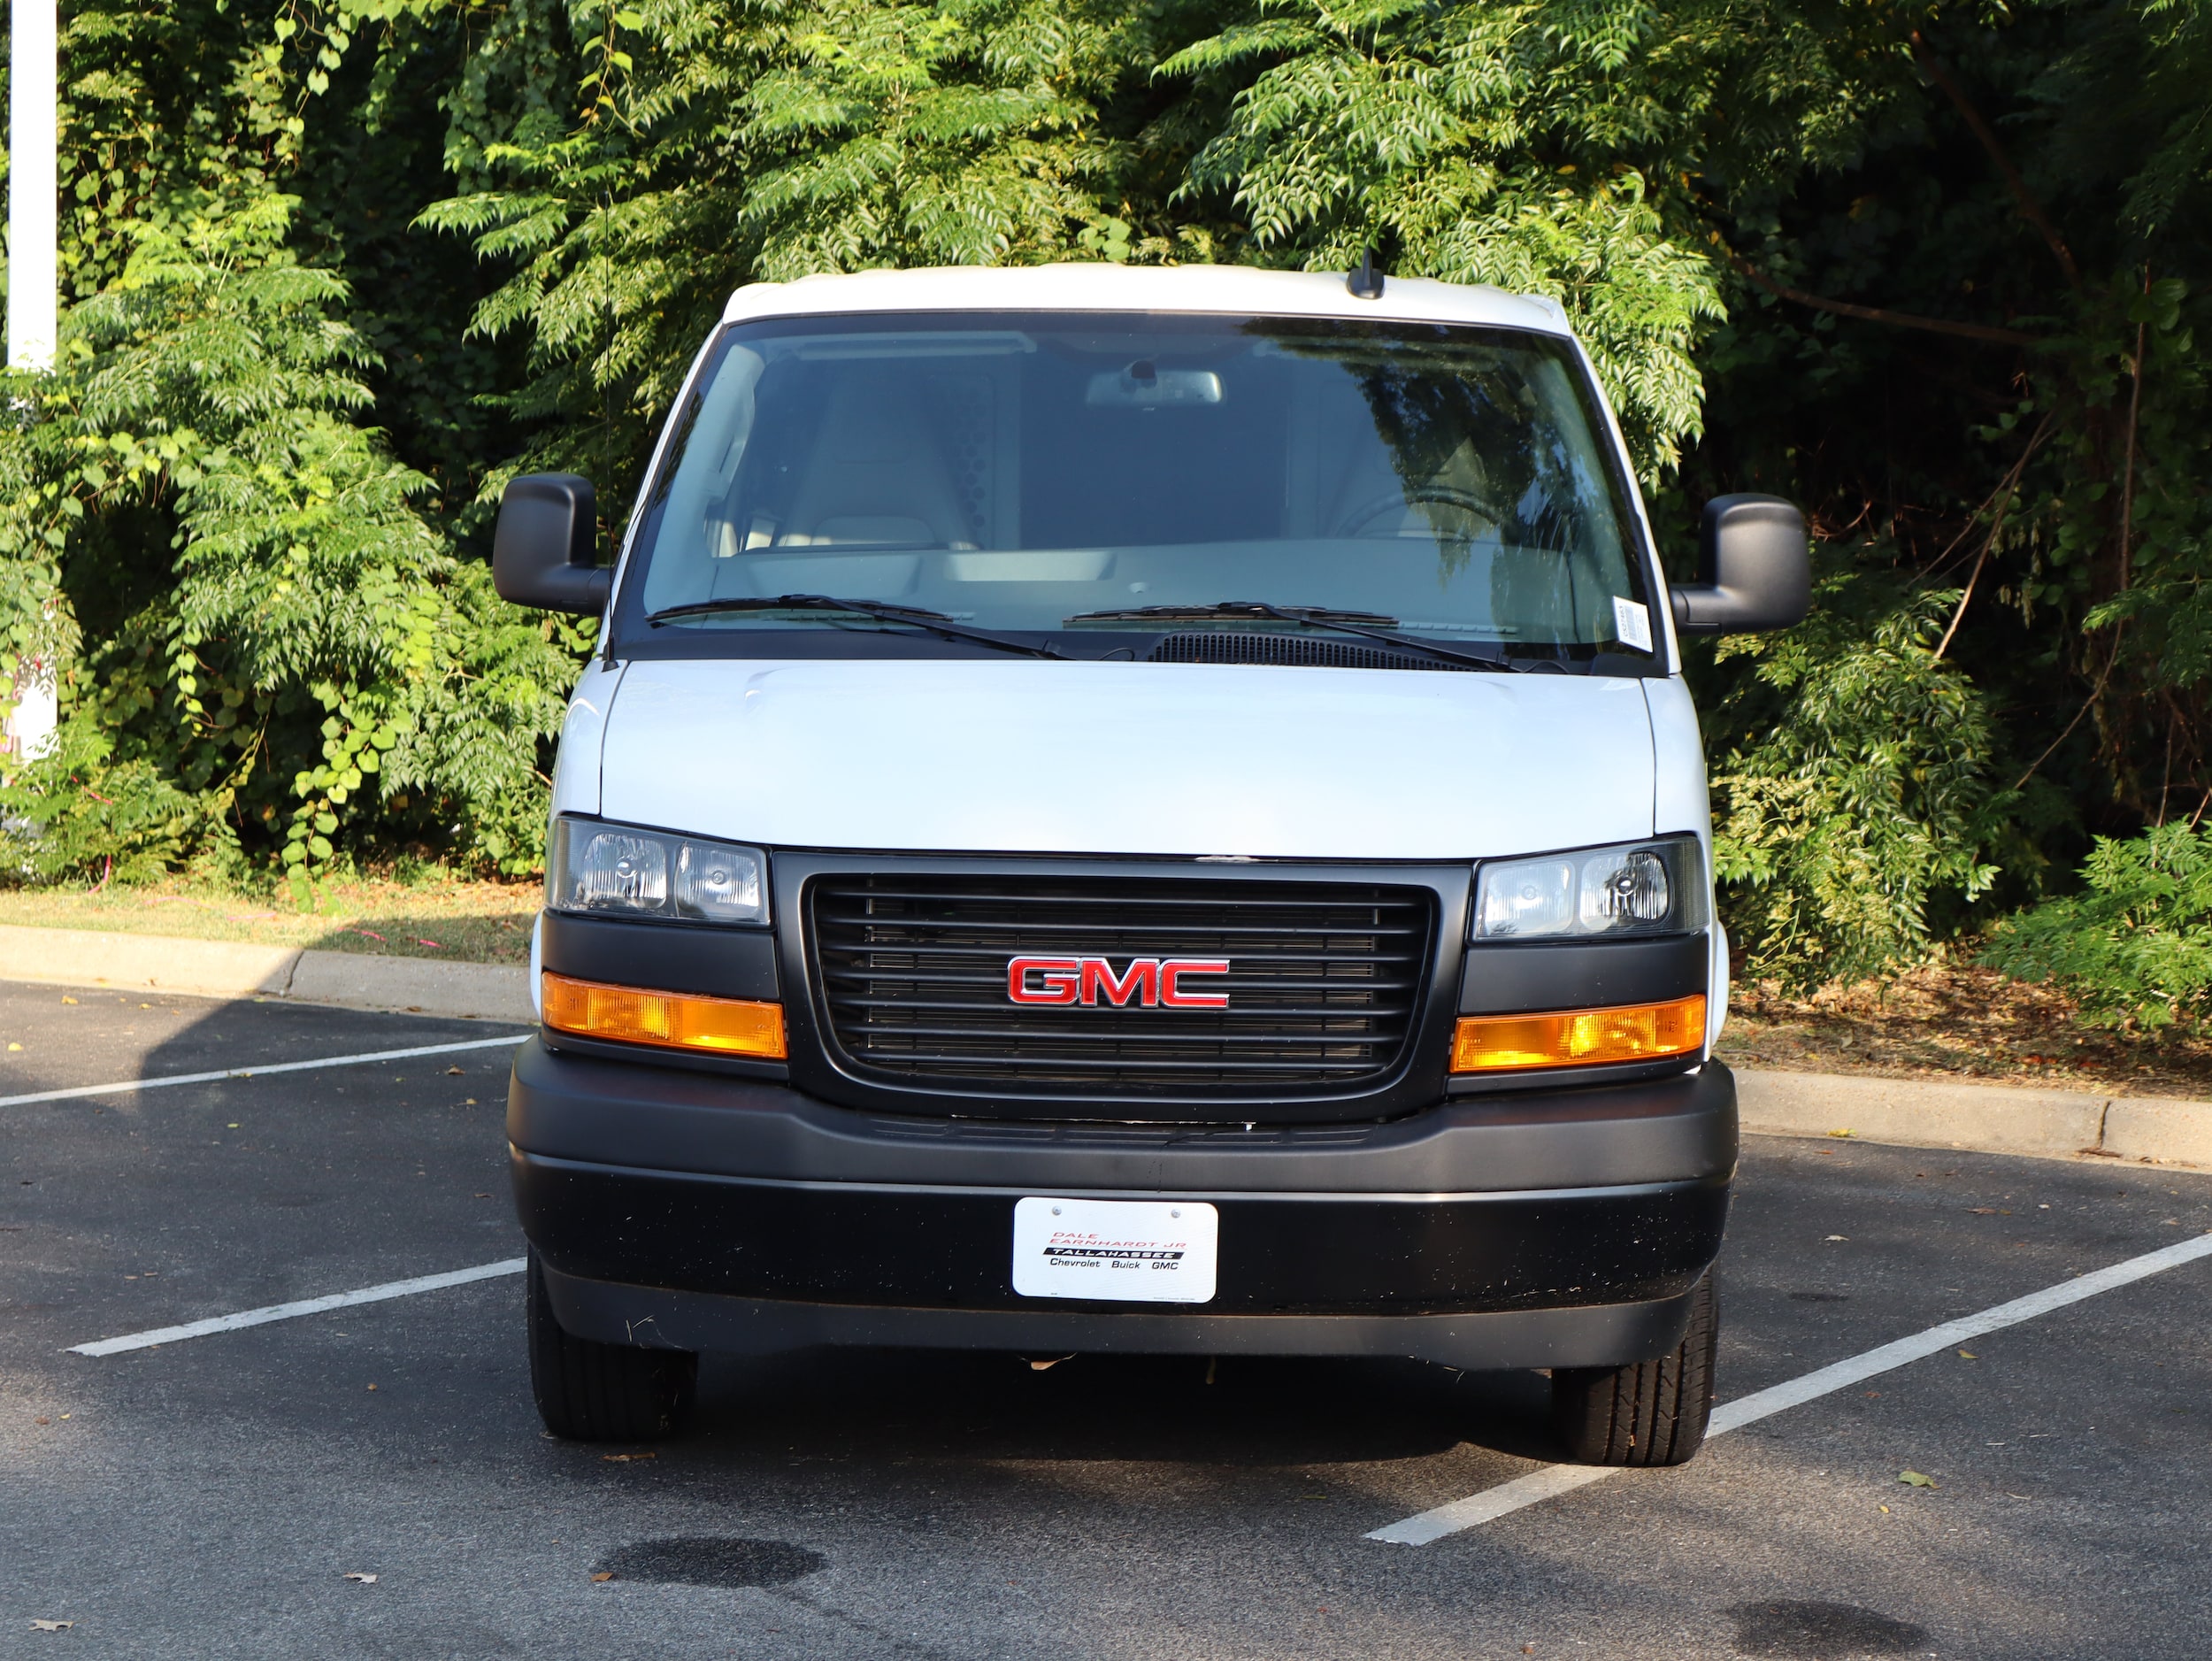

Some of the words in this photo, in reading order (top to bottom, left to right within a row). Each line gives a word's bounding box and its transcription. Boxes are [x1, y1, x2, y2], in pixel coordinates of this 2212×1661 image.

[1007, 956, 1231, 1009] GMC
[1049, 1239, 1159, 1248] EARNHARDT
[1052, 1249, 1176, 1259] TALLAHASSEE
[1049, 1257, 1101, 1268] Chevrolet
[1111, 1260, 1141, 1269] Buick
